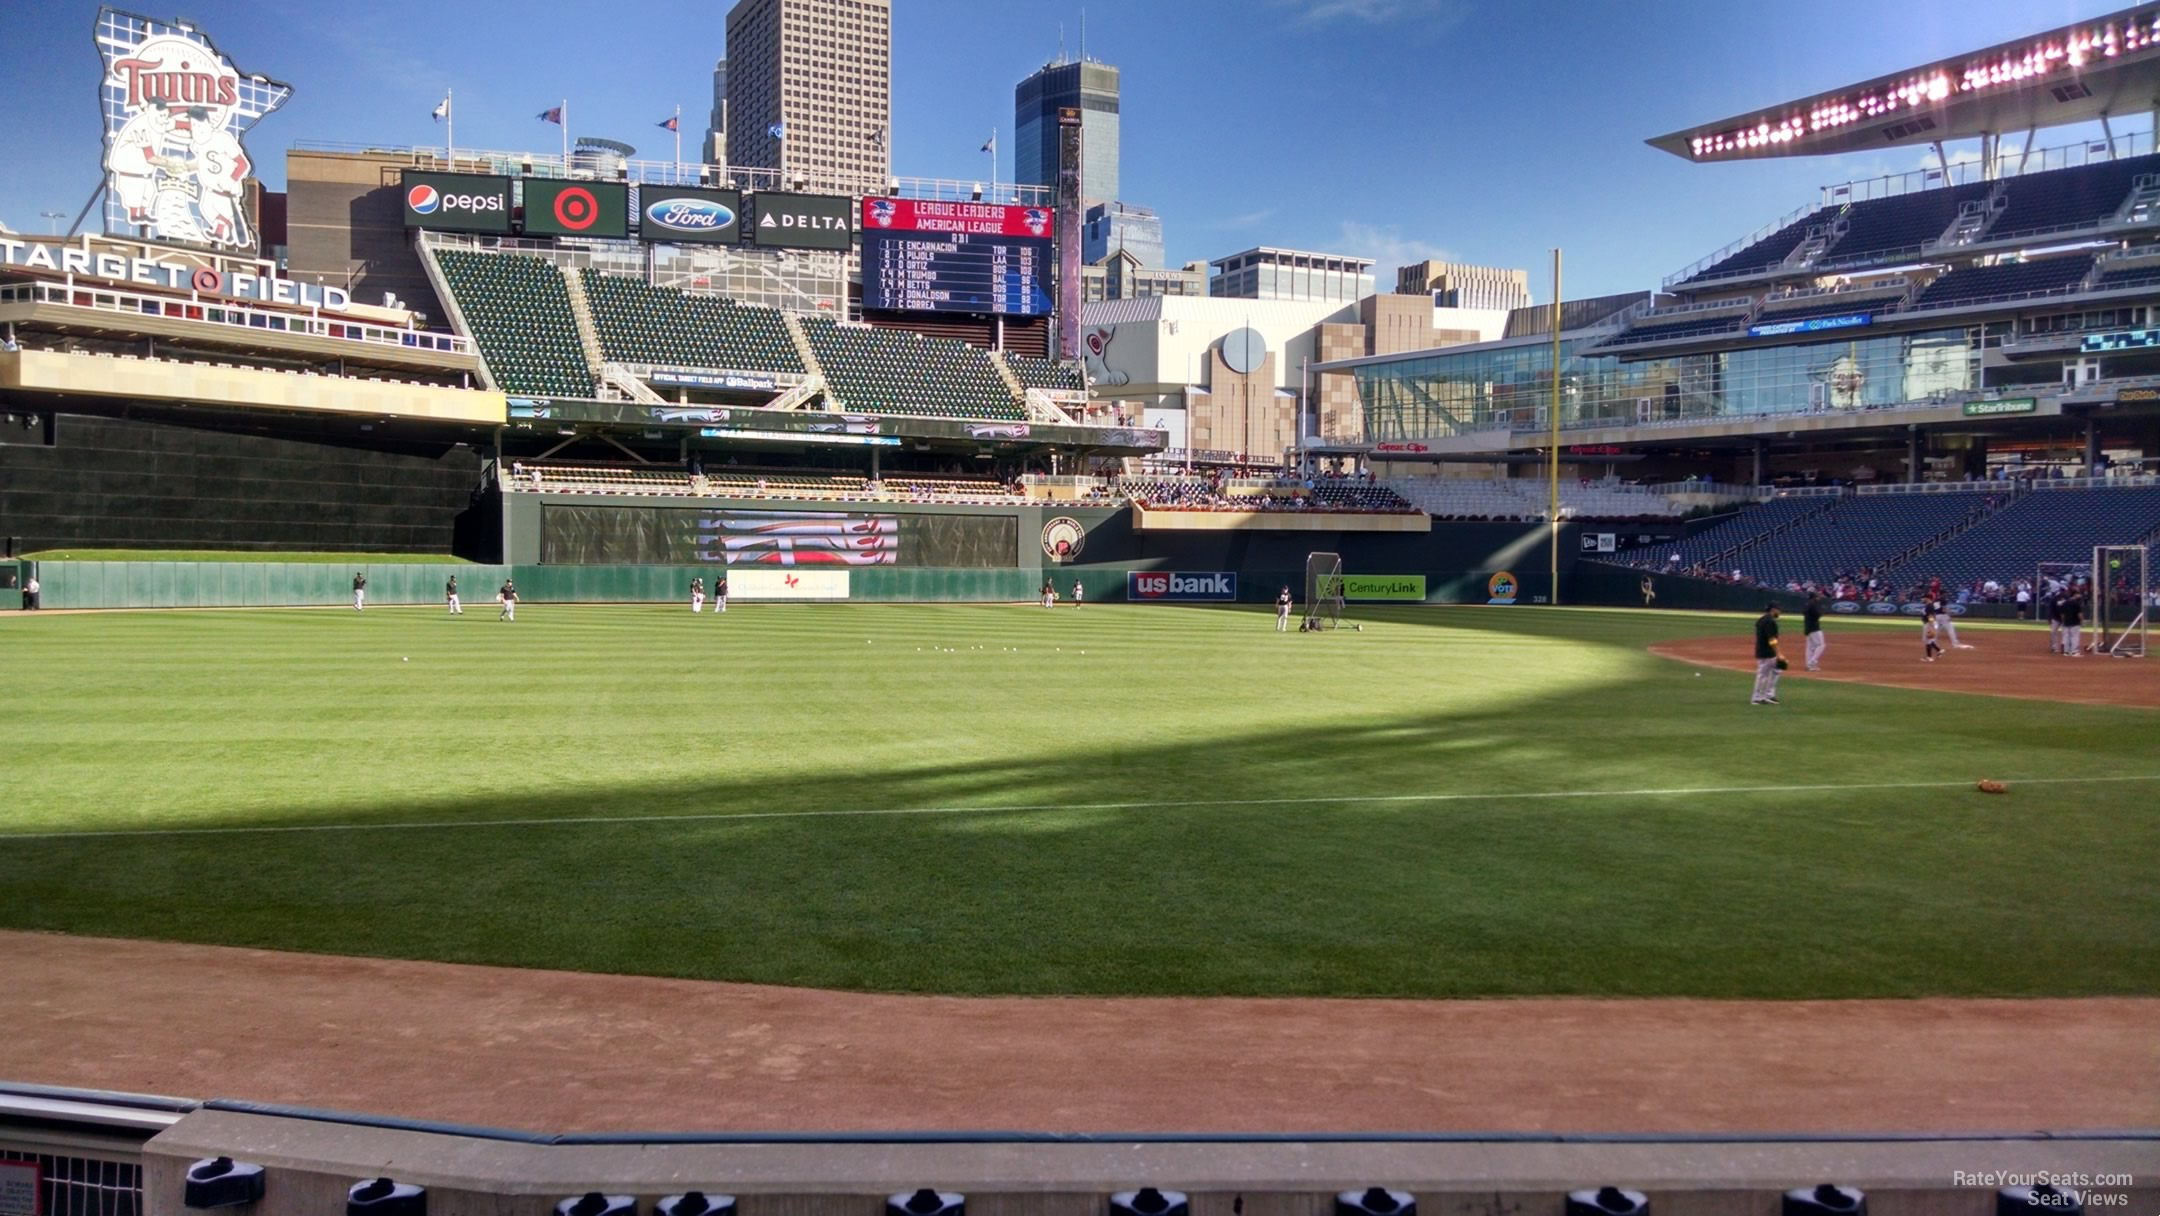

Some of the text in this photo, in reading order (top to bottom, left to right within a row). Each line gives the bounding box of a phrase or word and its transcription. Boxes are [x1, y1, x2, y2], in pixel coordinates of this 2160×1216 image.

[114, 58, 237, 107] Twins
[132, 129, 149, 144] M
[443, 193, 504, 214] pepsi
[914, 202, 1005, 219] LEAGUE LEADERS
[664, 202, 717, 227] Ford
[782, 213, 847, 230] DELTA
[916, 219, 1004, 234] AMERICAN LEAGUE
[952, 233, 969, 244] RBI
[898, 241, 904, 249] E
[906, 241, 958, 252] ENCARNACION
[992, 246, 1007, 255] TOR
[898, 251, 904, 260] A
[906, 251, 934, 261] PUJOLS
[992, 256, 1007, 264] LAA
[1020, 257, 1032, 266] 103
[898, 261, 904, 269] D
[906, 261, 928, 270] ORTIZ
[992, 265, 1007, 273] BOS
[0, 239, 350, 311] TARGET FIELD
[881, 269, 886, 278] T
[898, 271, 904, 279] M
[906, 271, 936, 280] TRUMBO
[992, 275, 1006, 284] BAL
[881, 279, 886, 287] T
[898, 280, 904, 289] M
[906, 280, 930, 289] BETTS
[992, 284, 1007, 293] BOS
[898, 290, 904, 298] J
[906, 290, 950, 300] DONALDSON
[992, 294, 1006, 302] TOR
[906, 300, 935, 309] CORREA
[992, 304, 1006, 312] HOU
[736, 378, 773, 389] Ballpark
[1978, 400, 2031, 413] StarTribune
[1377, 442, 1428, 453] Great Clips
[1350, 582, 1416, 595] CenturyLink
